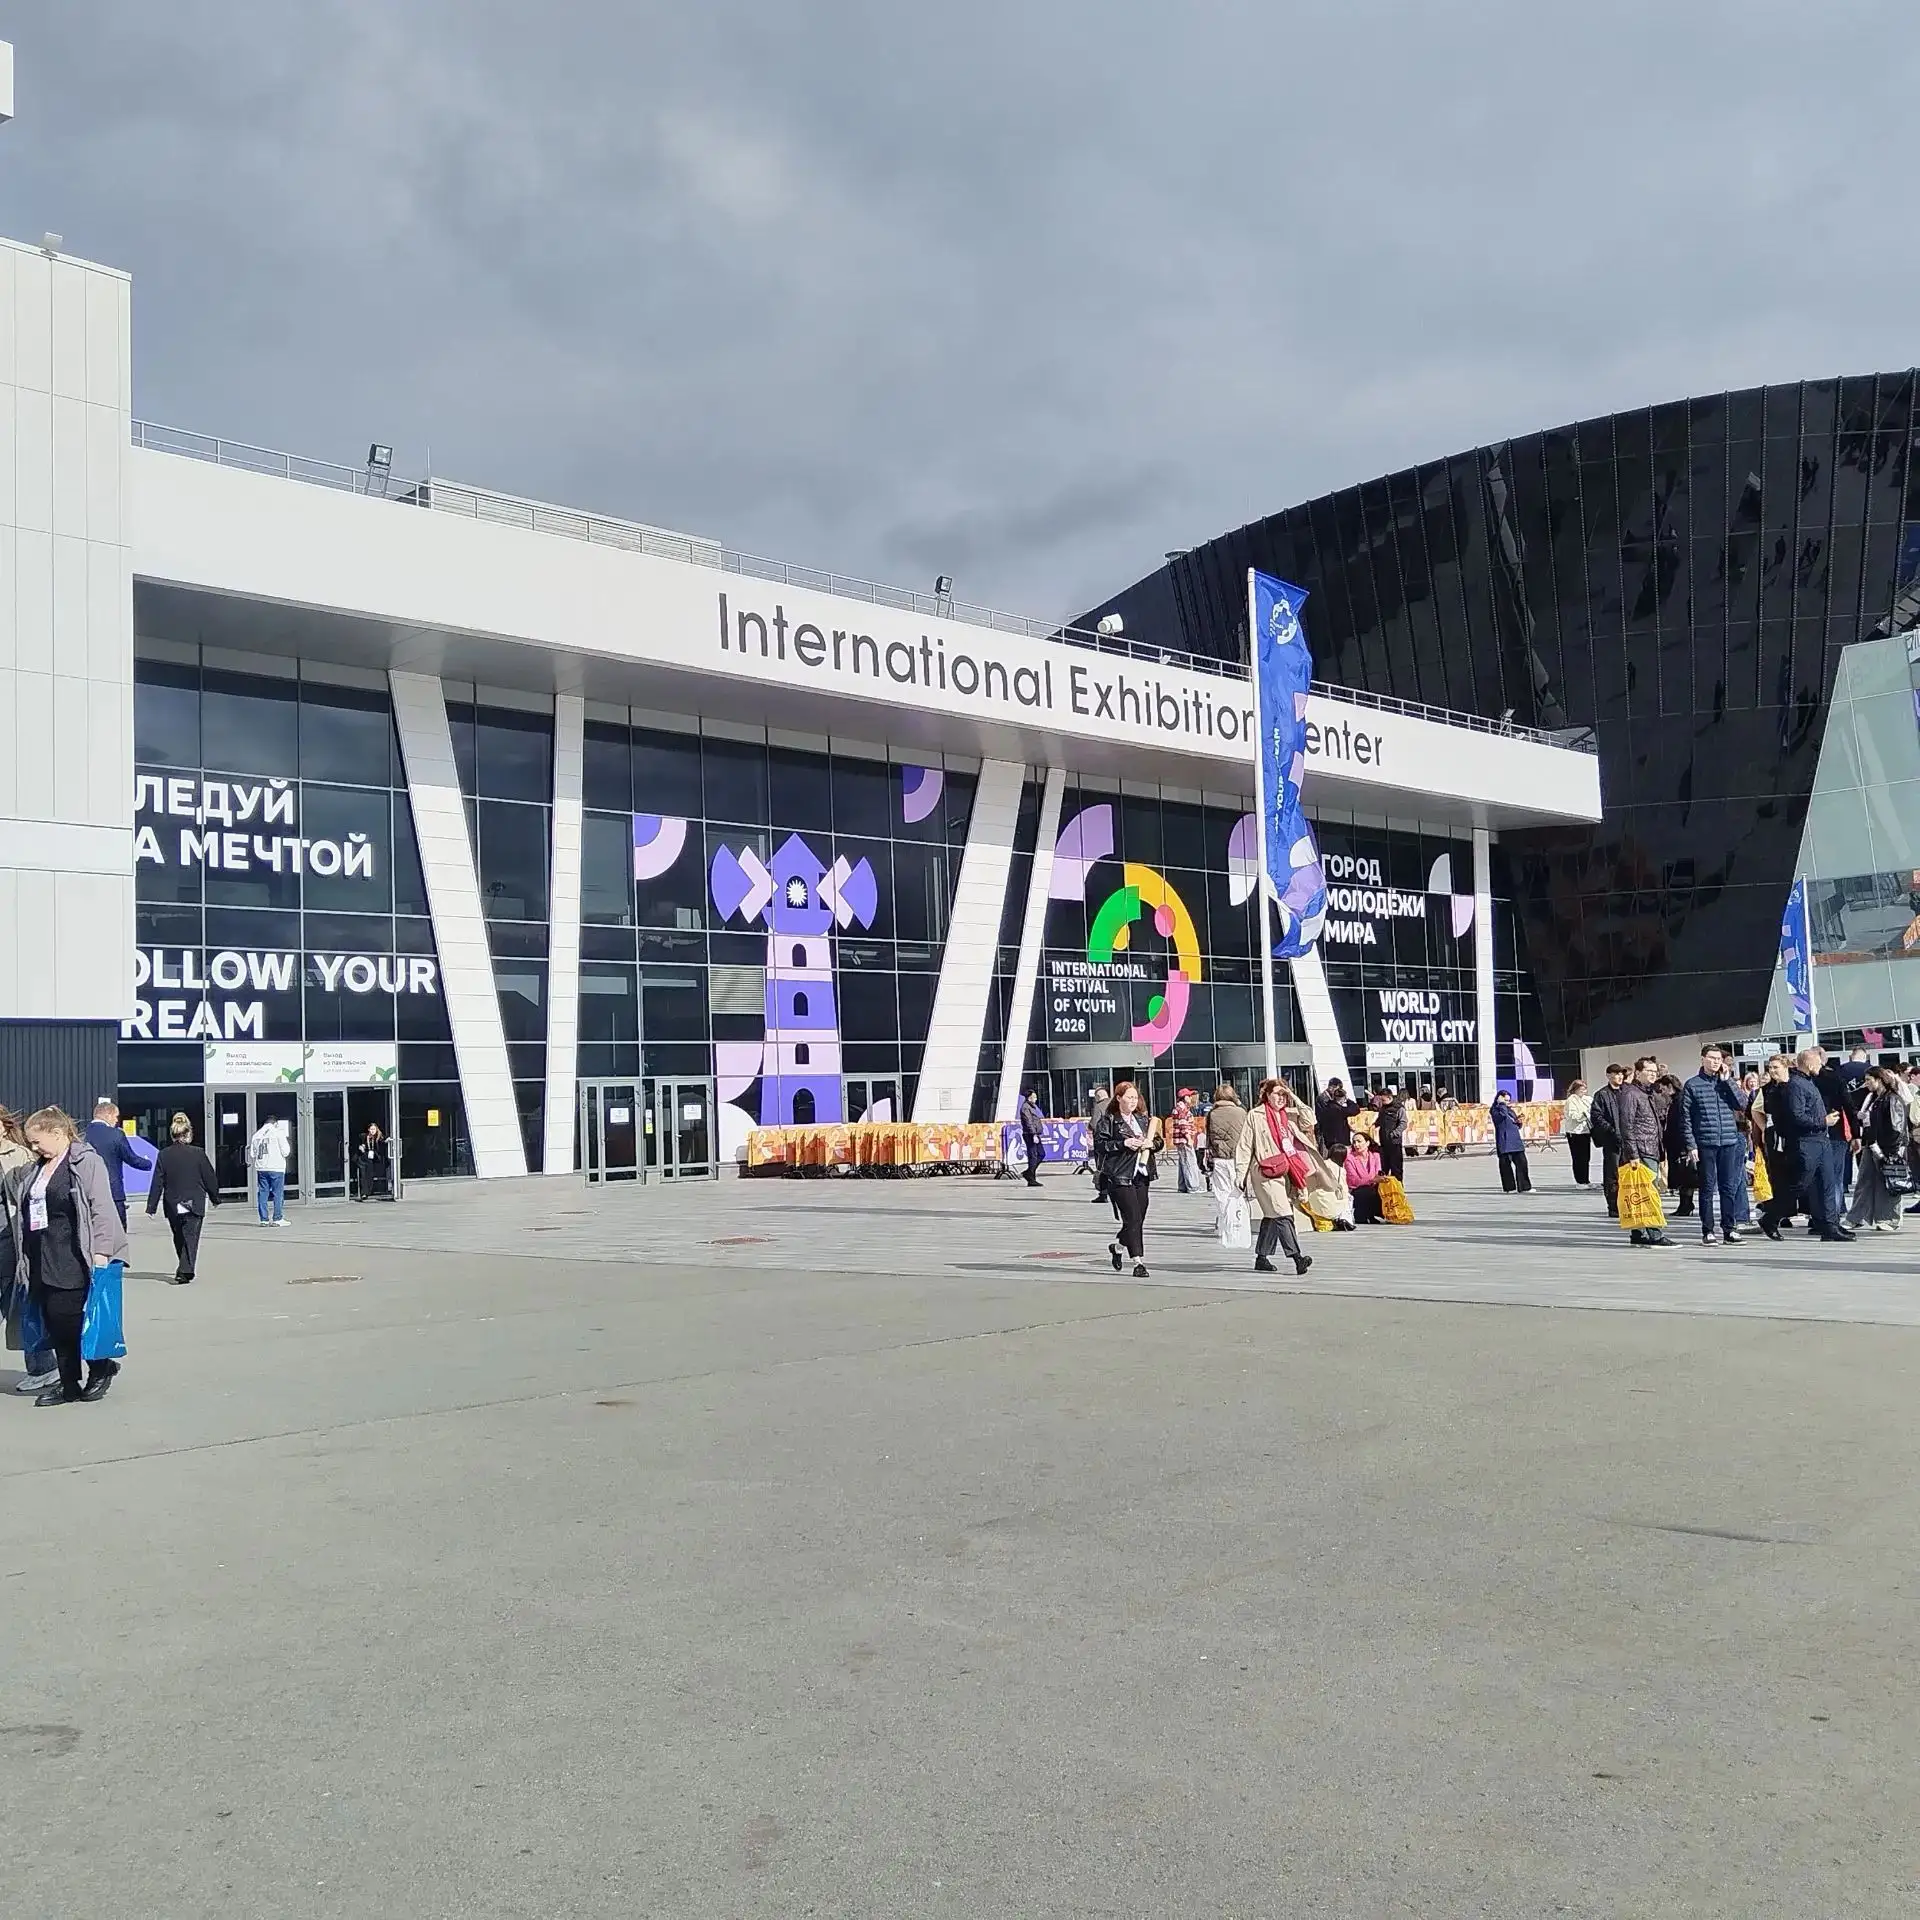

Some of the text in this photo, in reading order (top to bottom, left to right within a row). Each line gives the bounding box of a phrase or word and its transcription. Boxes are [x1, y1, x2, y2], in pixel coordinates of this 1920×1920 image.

[718, 592, 1053, 708] International
[1304, 719, 1383, 766] enter
[135, 774, 294, 828] ЛЕДУЙ
[135, 826, 373, 878] А МЕЧТОЙ
[1321, 853, 1383, 886] ГОРОД
[1326, 888, 1426, 920] МОЛОДЁЖИ
[1324, 919, 1377, 945] МИРА
[313, 955, 437, 995] YOUR
[1051, 960, 1148, 979] INTERNATIONAL
[1052, 978, 1110, 994] FESTIVAL
[1053, 998, 1116, 1013] OF YOUTH
[1379, 990, 1441, 1015] WORLD
[121, 1000, 264, 1040] REAM
[1054, 1018, 1086, 1032] 2026
[1380, 1018, 1476, 1042] YOUTH CITY
